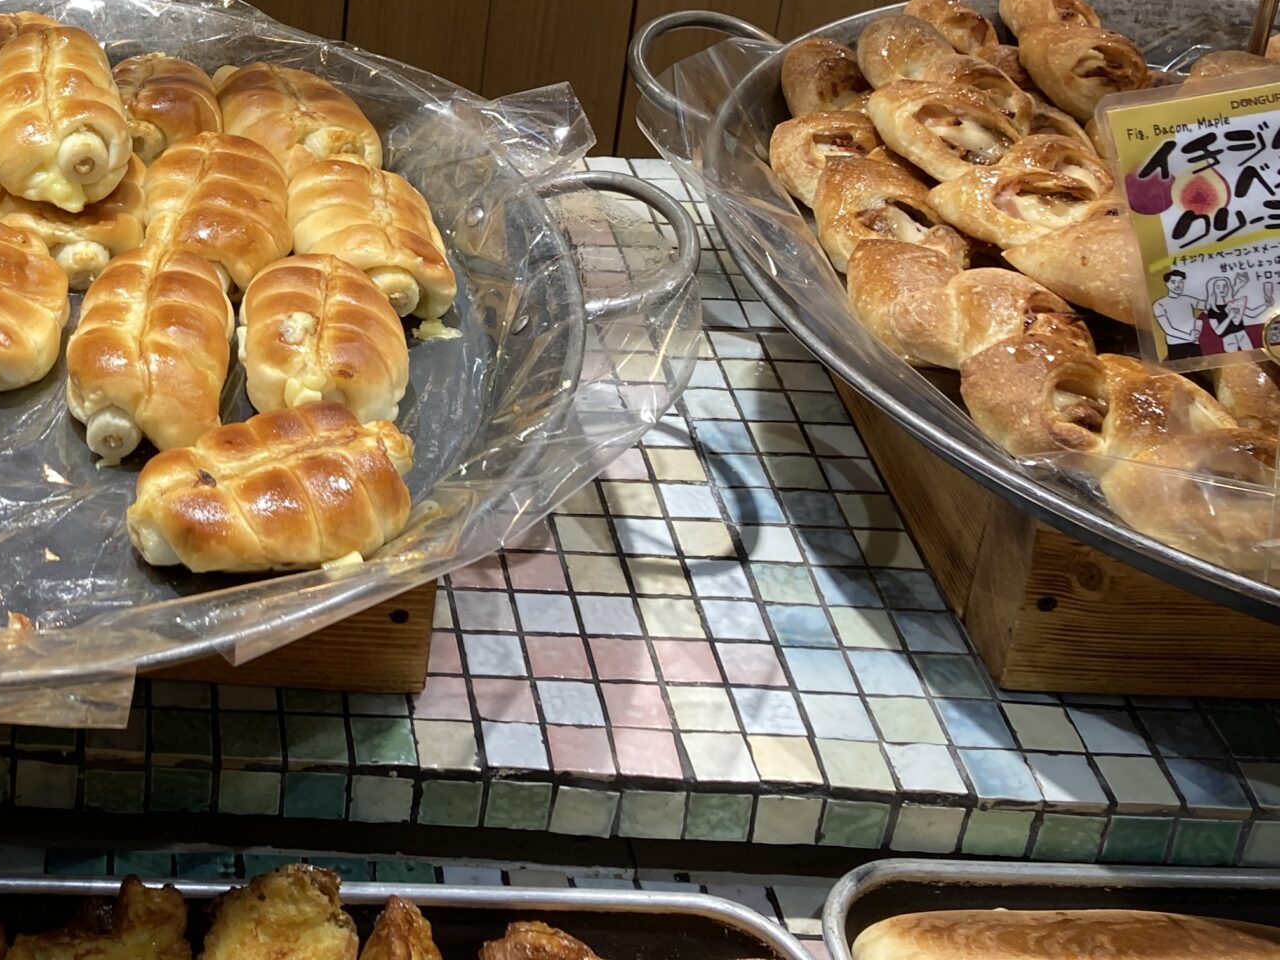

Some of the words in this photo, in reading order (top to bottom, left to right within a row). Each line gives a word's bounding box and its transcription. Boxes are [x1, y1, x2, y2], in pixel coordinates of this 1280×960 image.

[1196, 113, 1231, 130] Maple
[1138, 121, 1280, 180] イチジ
